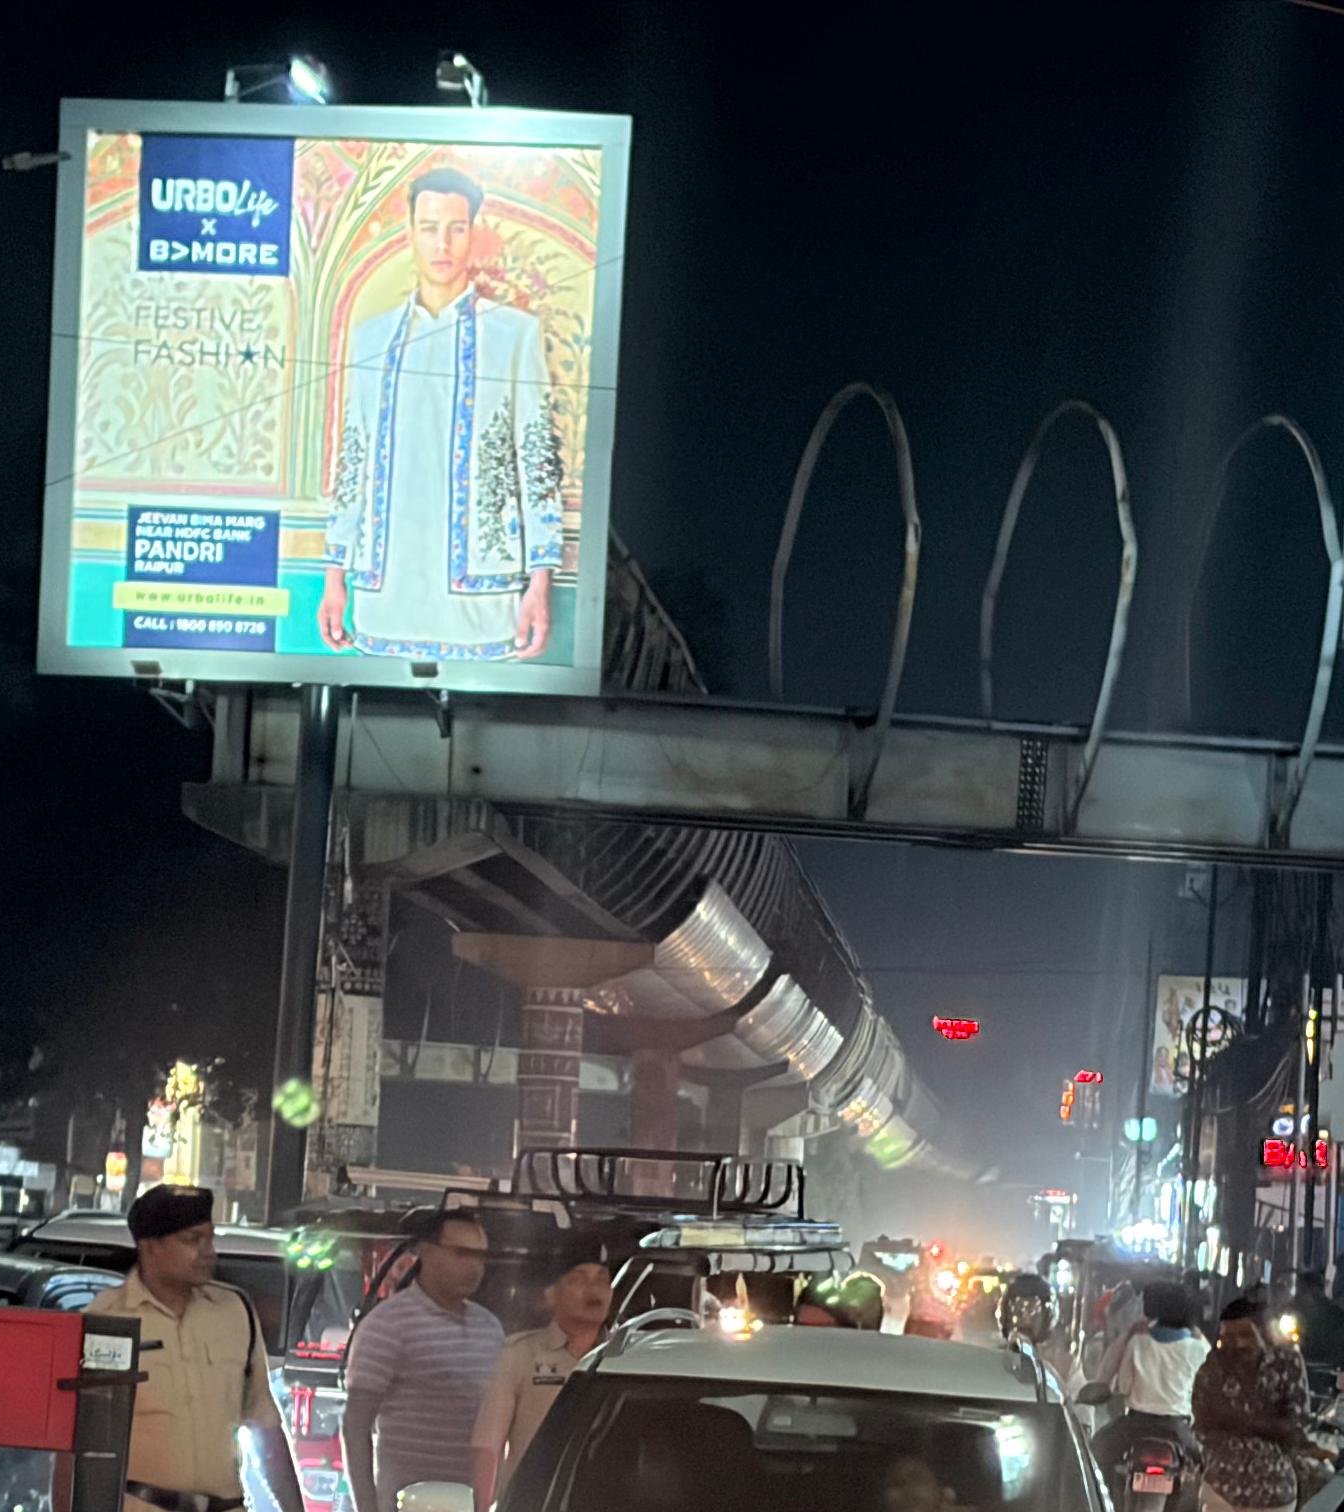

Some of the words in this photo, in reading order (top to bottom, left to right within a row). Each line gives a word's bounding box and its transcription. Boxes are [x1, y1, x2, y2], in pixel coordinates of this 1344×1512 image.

[134, 305, 262, 333] FESTIVE
[134, 539, 224, 563] PANDRI
[133, 616, 168, 630] CALL
